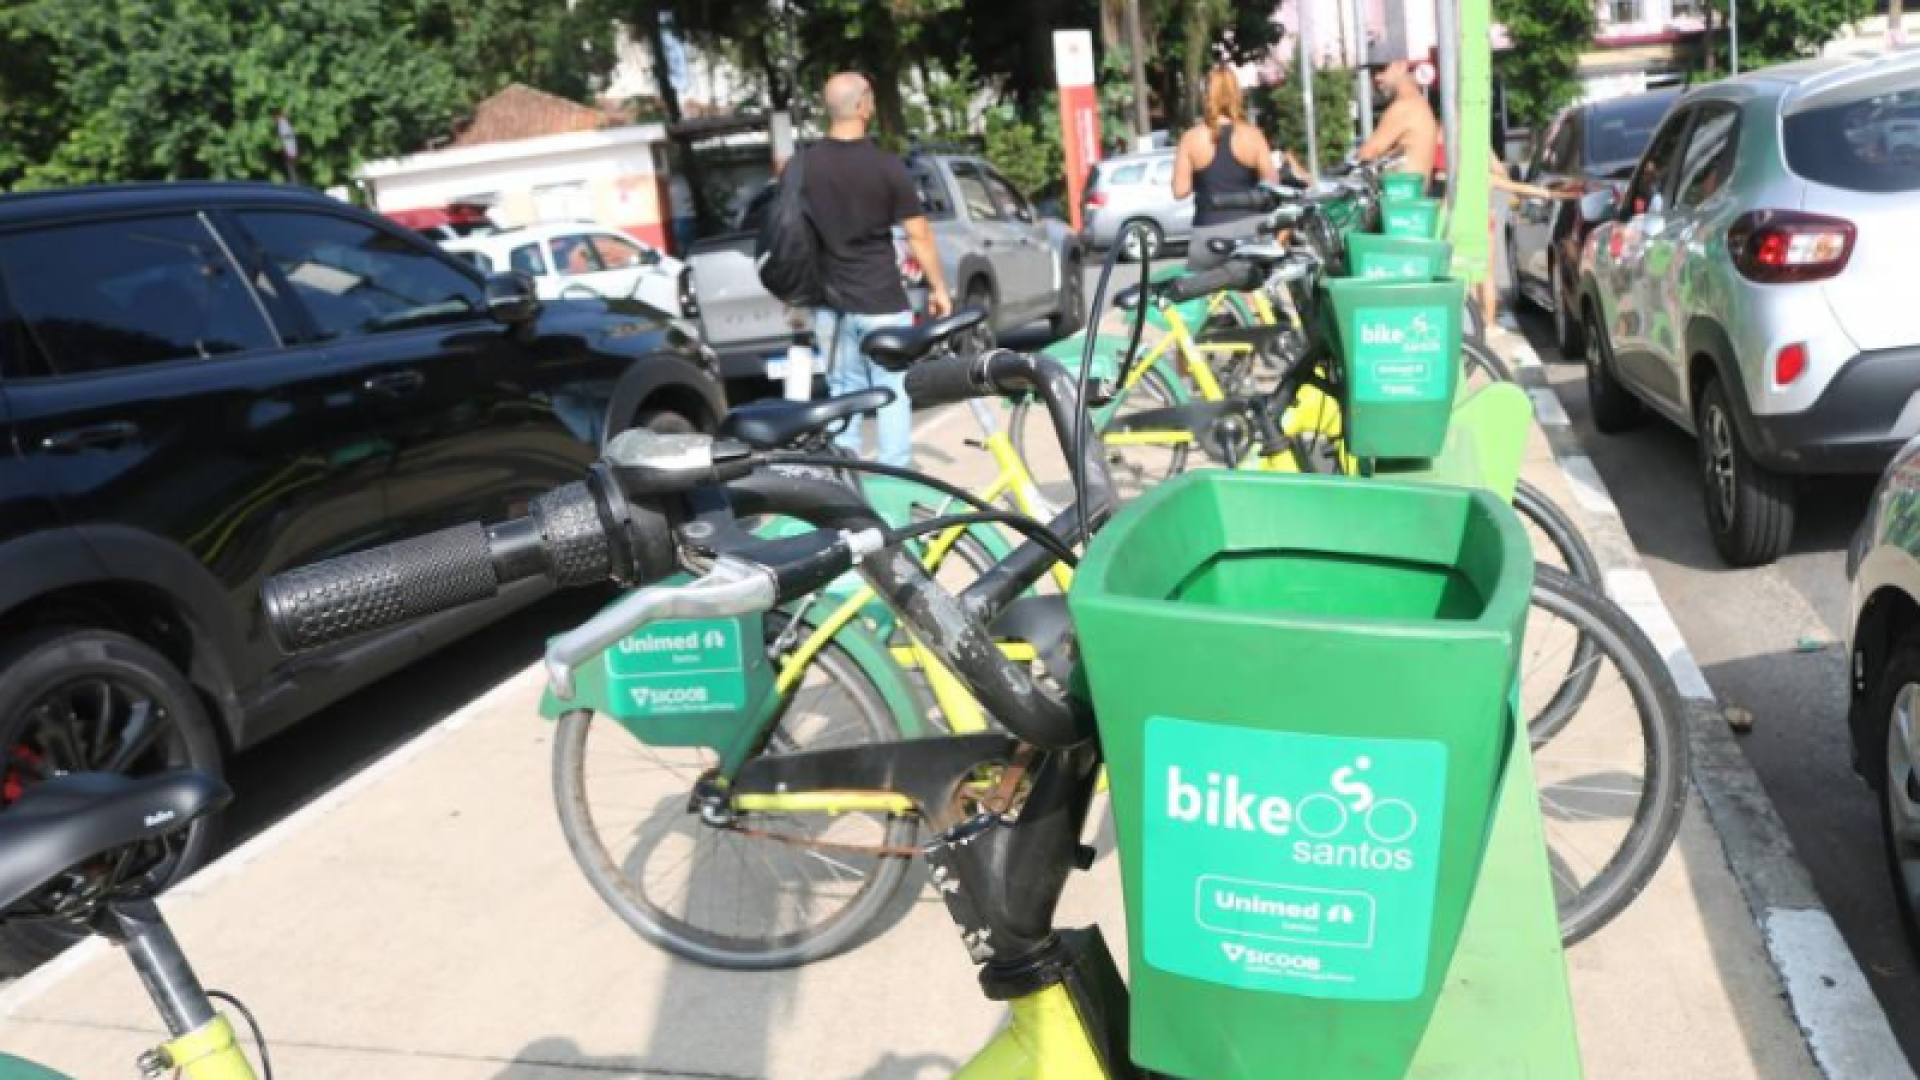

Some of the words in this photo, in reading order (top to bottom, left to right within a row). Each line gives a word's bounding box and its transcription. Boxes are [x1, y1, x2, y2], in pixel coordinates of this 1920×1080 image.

[1361, 322, 1403, 344] bike
[618, 631, 699, 653] Unimed
[1167, 765, 1292, 836] bike
[1292, 840, 1413, 871] santos
[1214, 890, 1320, 919] Unimed
